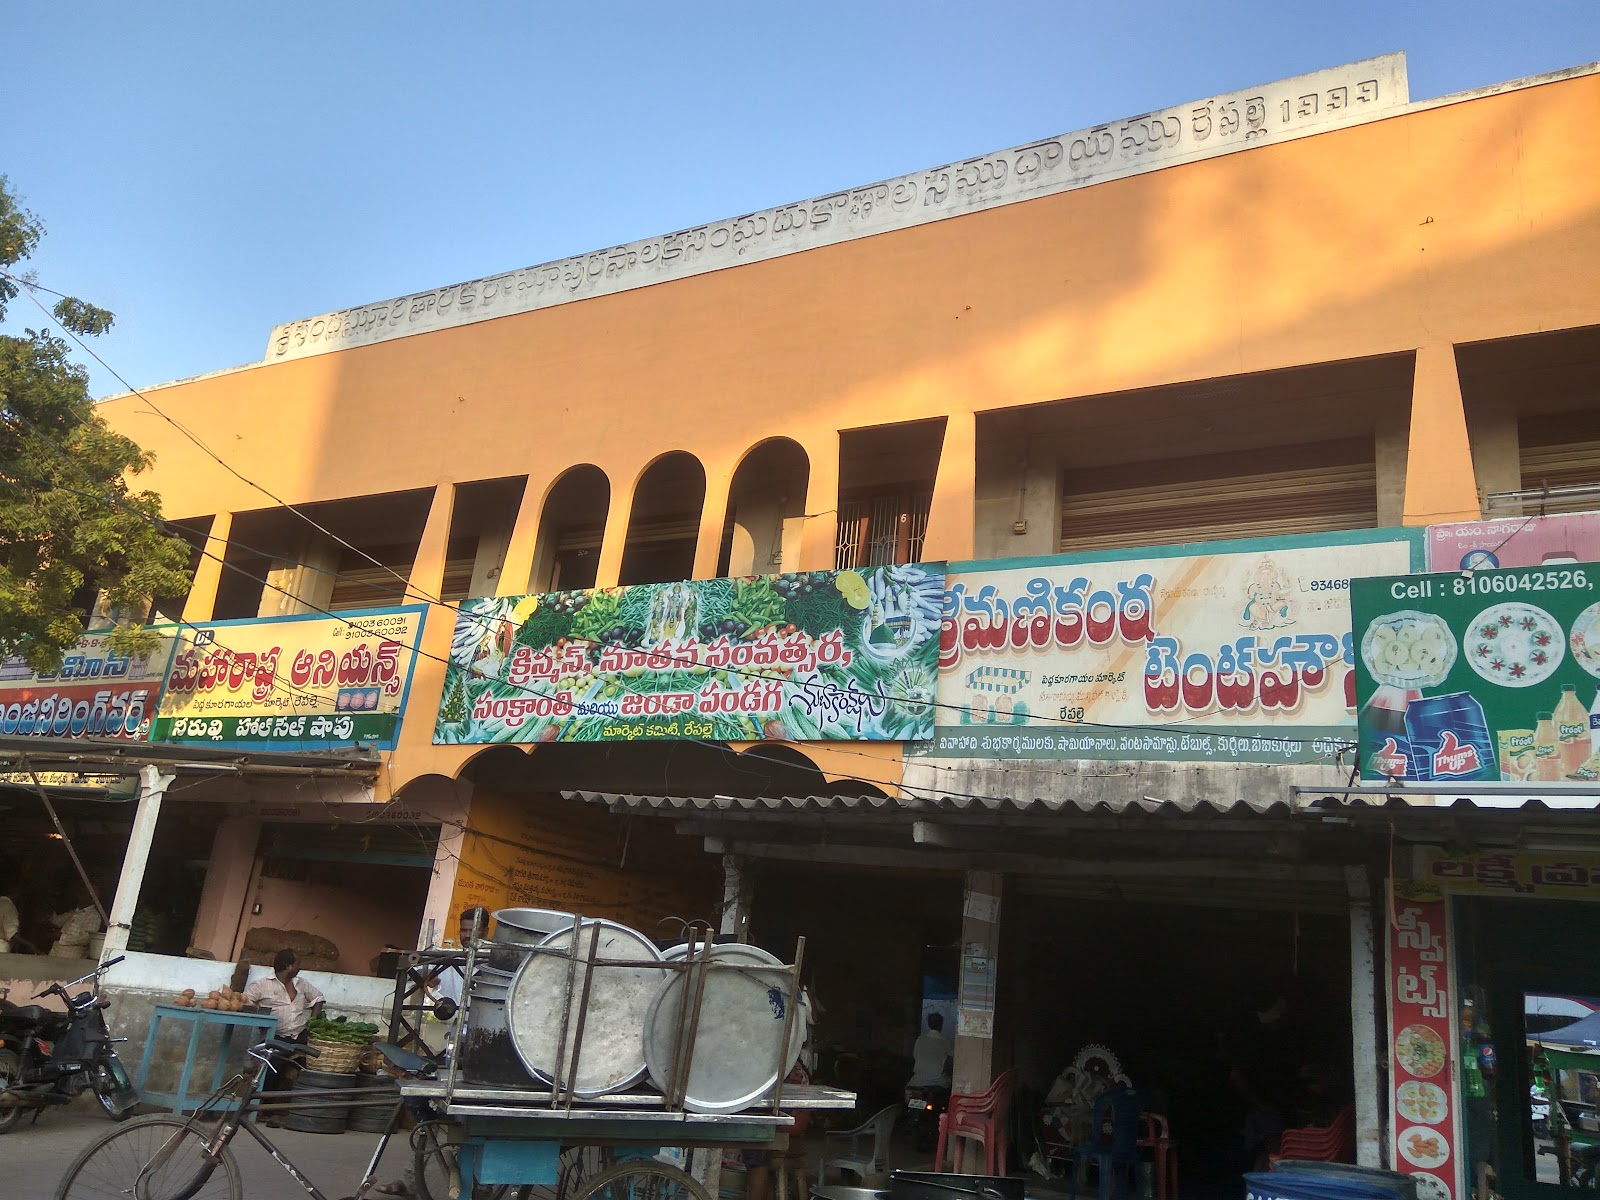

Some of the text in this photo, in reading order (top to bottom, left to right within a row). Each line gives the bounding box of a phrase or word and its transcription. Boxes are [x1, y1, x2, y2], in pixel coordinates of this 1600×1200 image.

[1280, 79, 1378, 122] 1999
[1391, 581, 1432, 600] Cell
[600, 641, 699, 672] నూతన
[291, 641, 401, 694] ఆనియన్స్
[473, 691, 573, 727] సంక్రాంతి
[577, 701, 618, 716] మరియు
[621, 693, 695, 714] జండా
[700, 679, 784, 713] పండగ
[1060, 706, 1085, 723] రేపల్లె
[309, 716, 354, 740] షాపు
[684, 721, 713, 738] రేపల్లె
[939, 737, 978, 749] వివాహాది
[1437, 750, 1473, 767] Thums
